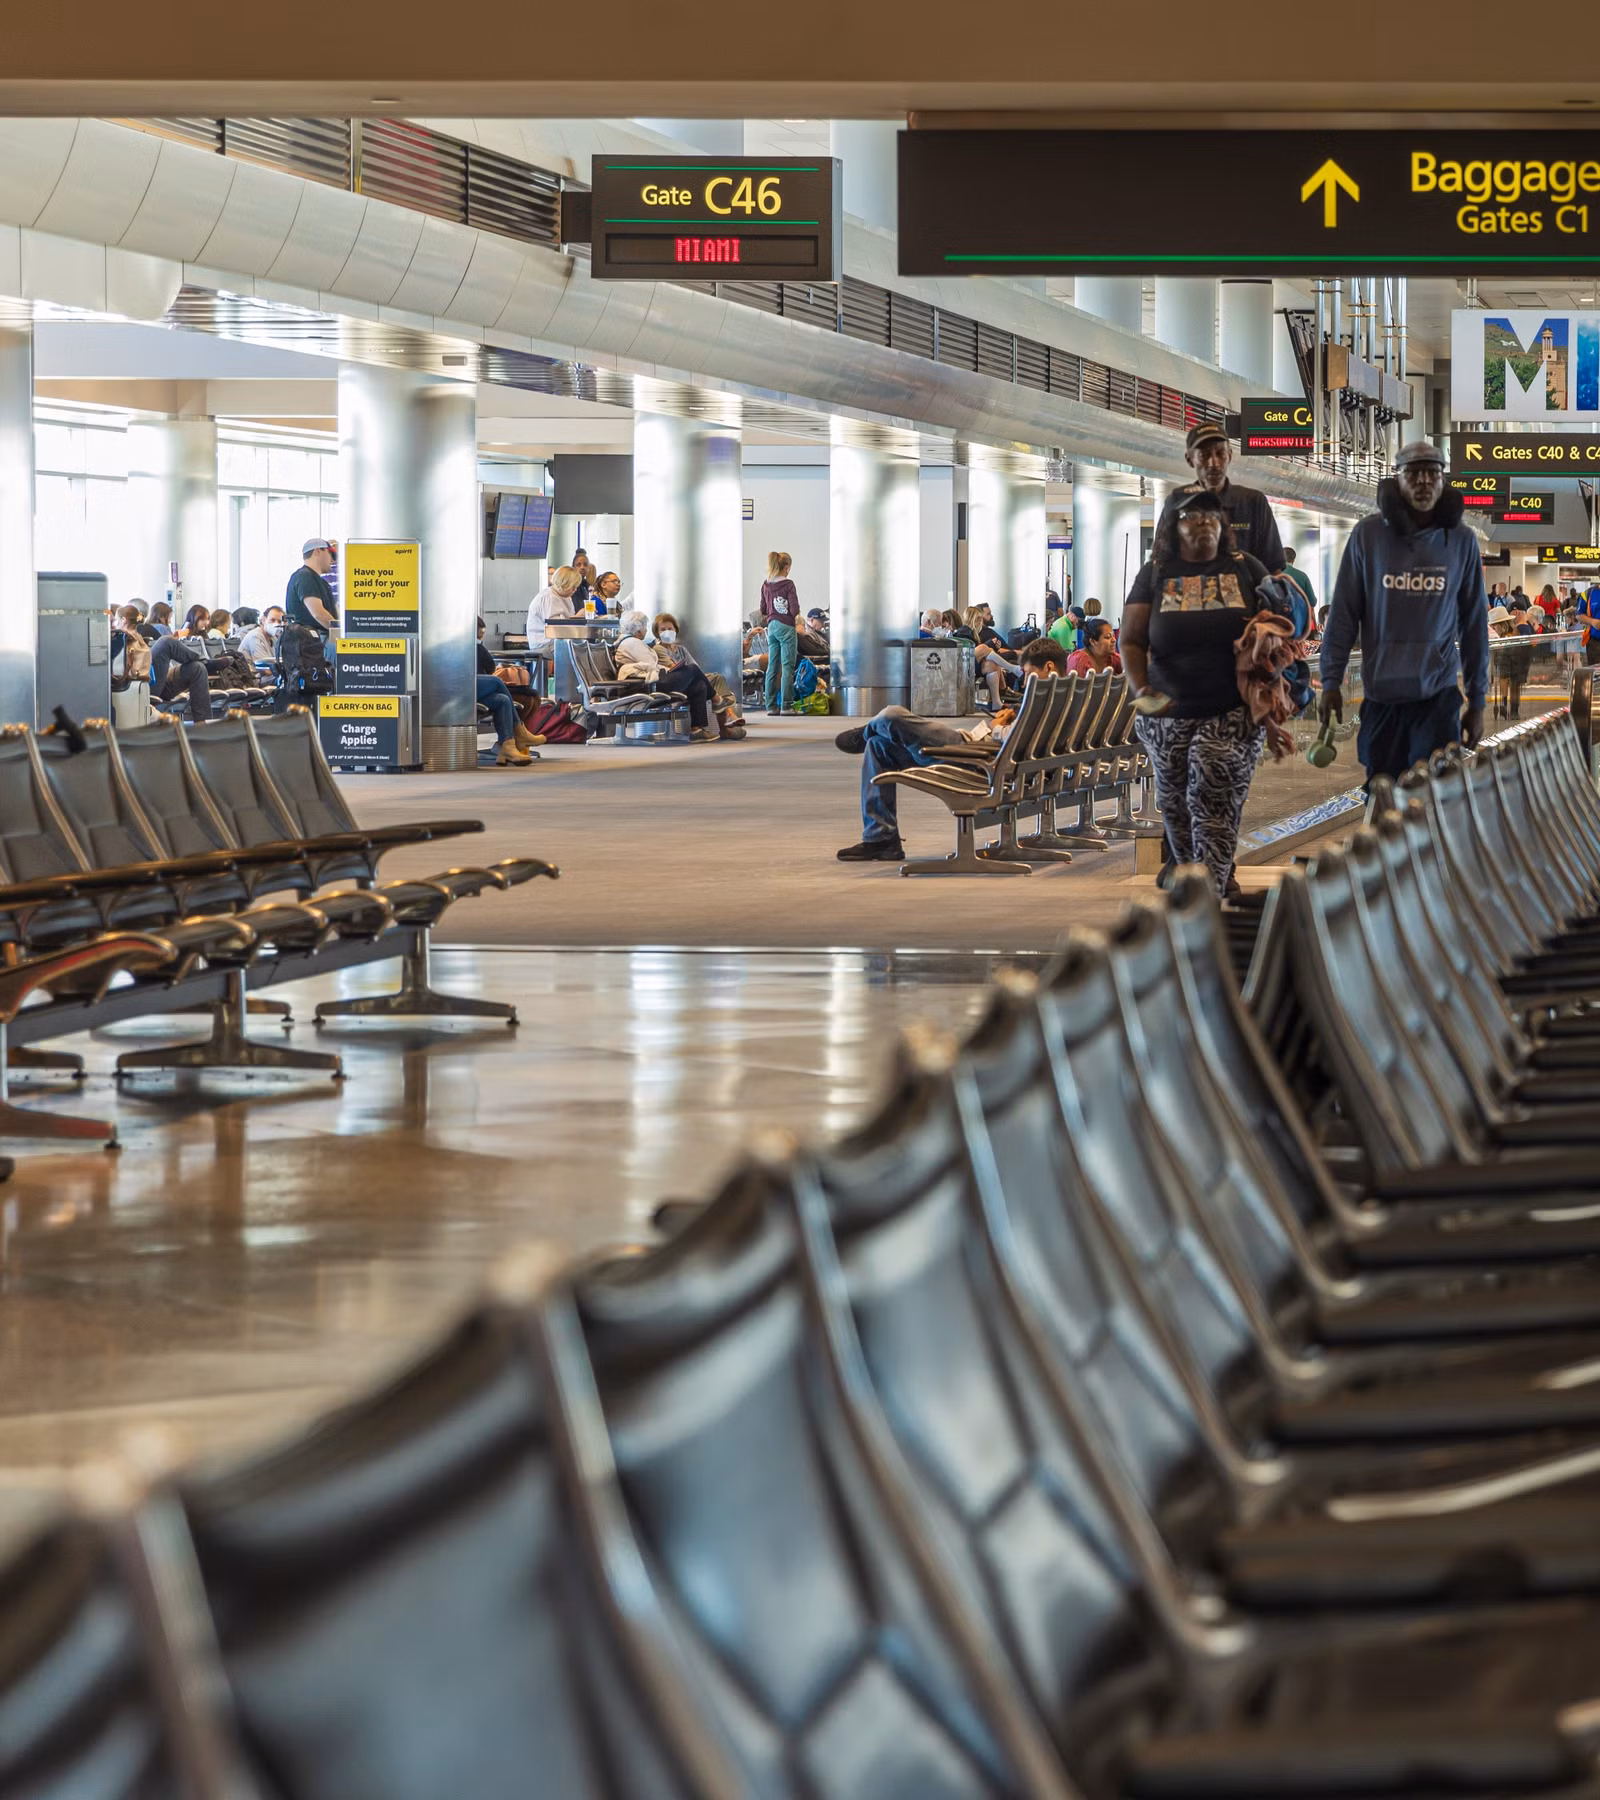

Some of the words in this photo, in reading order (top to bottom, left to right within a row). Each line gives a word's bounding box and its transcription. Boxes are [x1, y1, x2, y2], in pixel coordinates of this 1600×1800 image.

[641, 185, 692, 206] Gate
[705, 177, 782, 215] C46
[1456, 205, 1543, 234] Gates
[1555, 205, 1589, 233] C1
[675, 239, 741, 262] MIAMI
[1264, 411, 1288, 421] Gate
[1492, 445, 1533, 460] Gates
[1537, 445, 1564, 460] C40
[1569, 447, 1580, 460] &
[1472, 478, 1497, 491] C42
[1520, 497, 1542, 508] C40
[353, 568, 376, 576] Have
[377, 570, 394, 578] you
[353, 579, 373, 588] paid
[375, 579, 388, 587] for
[389, 581, 410, 589] your
[1383, 572, 1446, 591] adidas
[353, 590, 396, 600] carry-on?
[342, 664, 360, 672] One
[362, 664, 400, 672] Included
[341, 725, 377, 735] Charge
[340, 736, 378, 746] Applies
